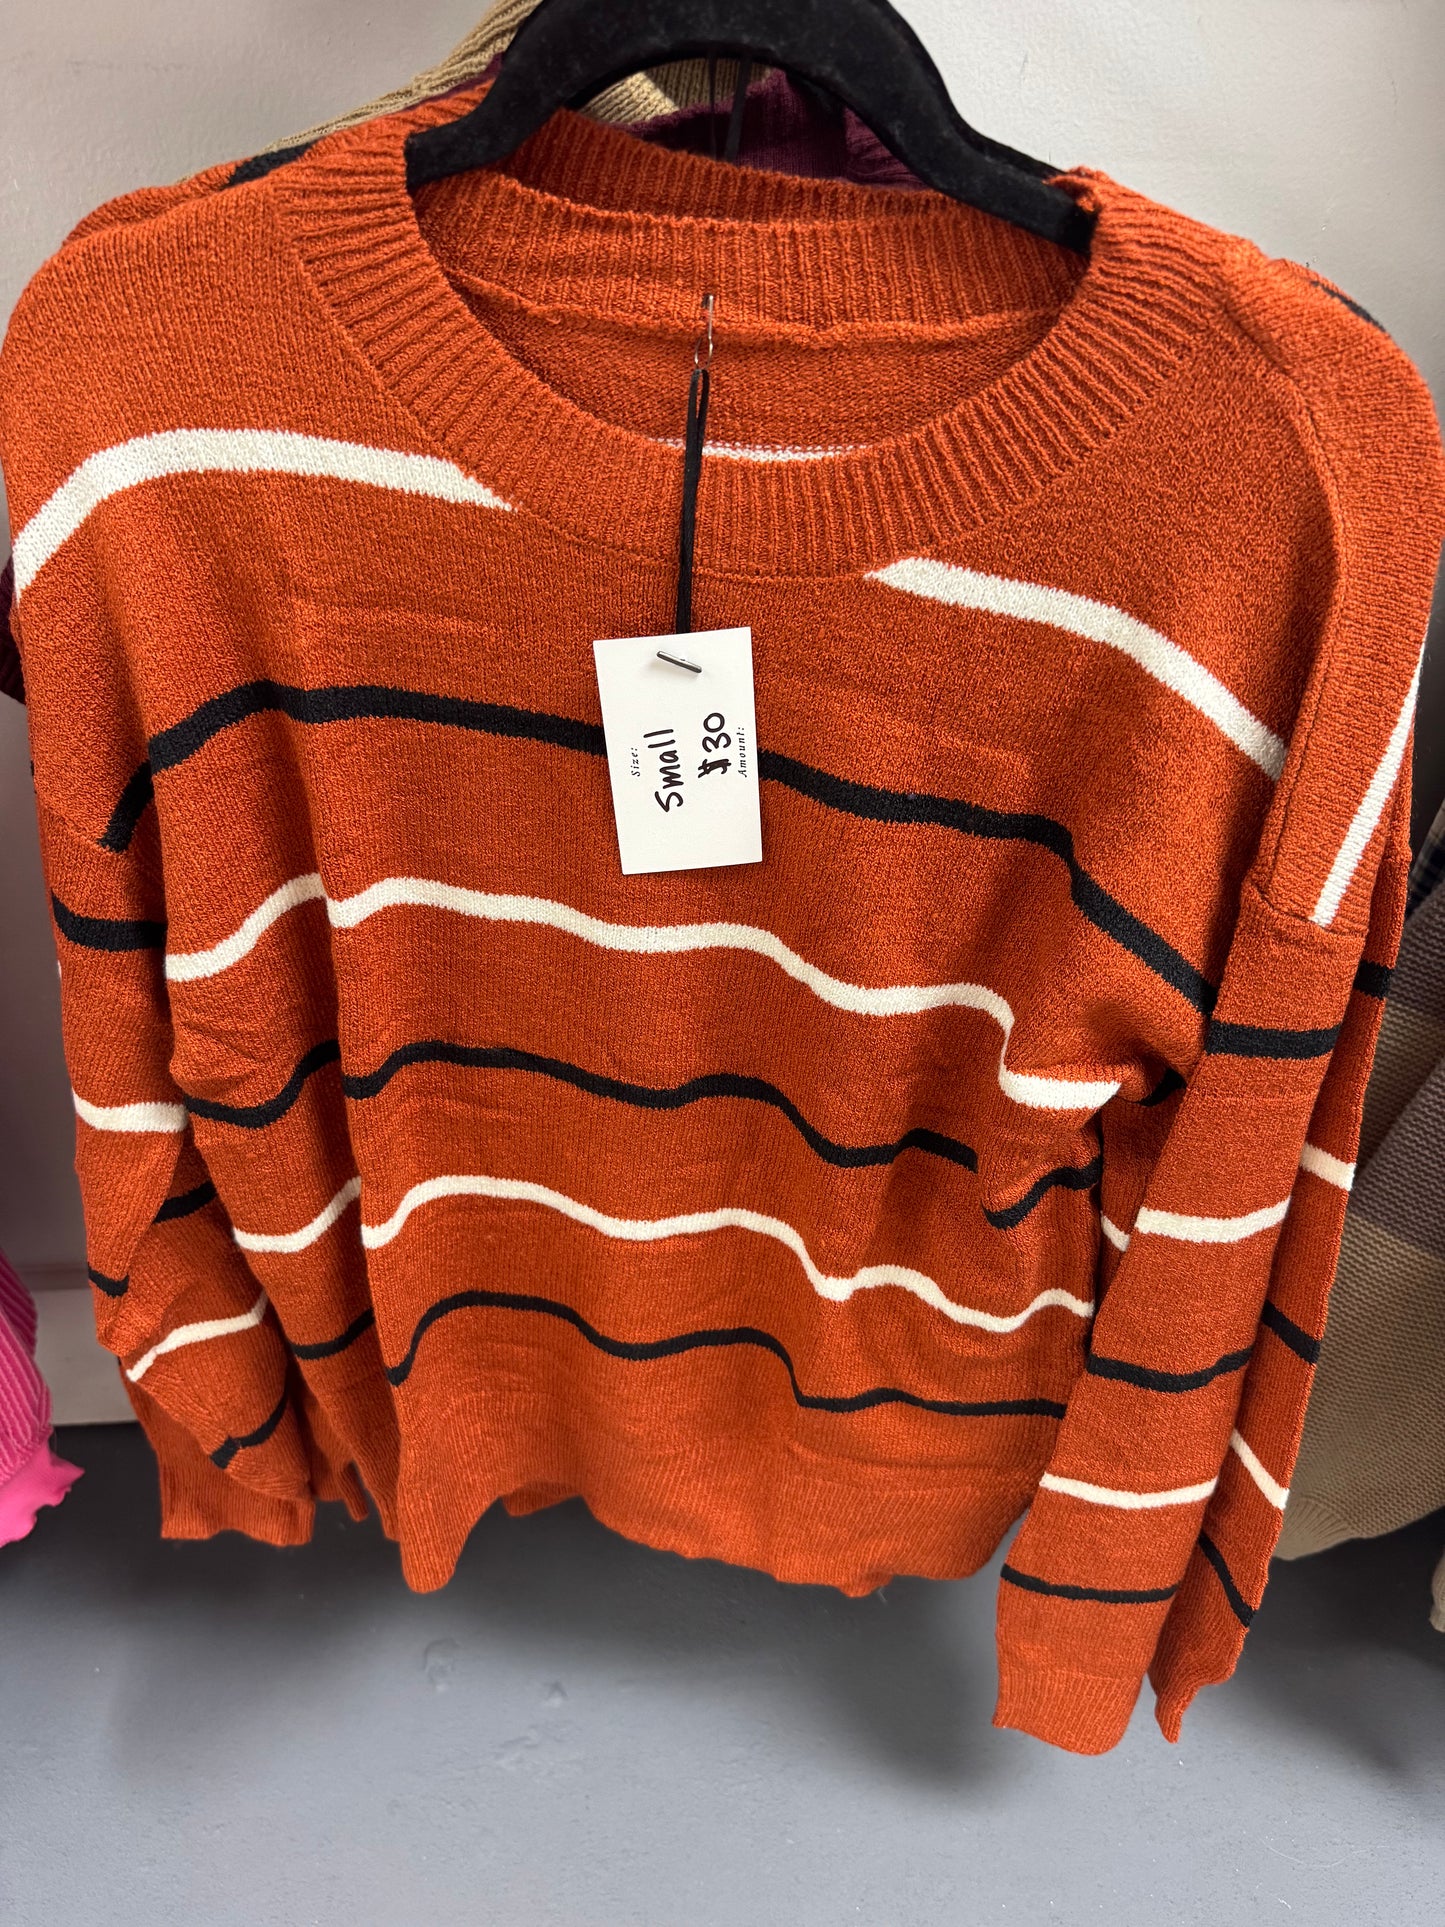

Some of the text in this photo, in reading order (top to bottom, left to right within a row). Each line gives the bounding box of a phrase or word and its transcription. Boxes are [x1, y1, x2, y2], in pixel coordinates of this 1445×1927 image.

[631, 747, 641, 777] Size:
[643, 728, 685, 813] Small
[697, 712, 732, 779] $30
[737, 727, 748, 778] Amount:
